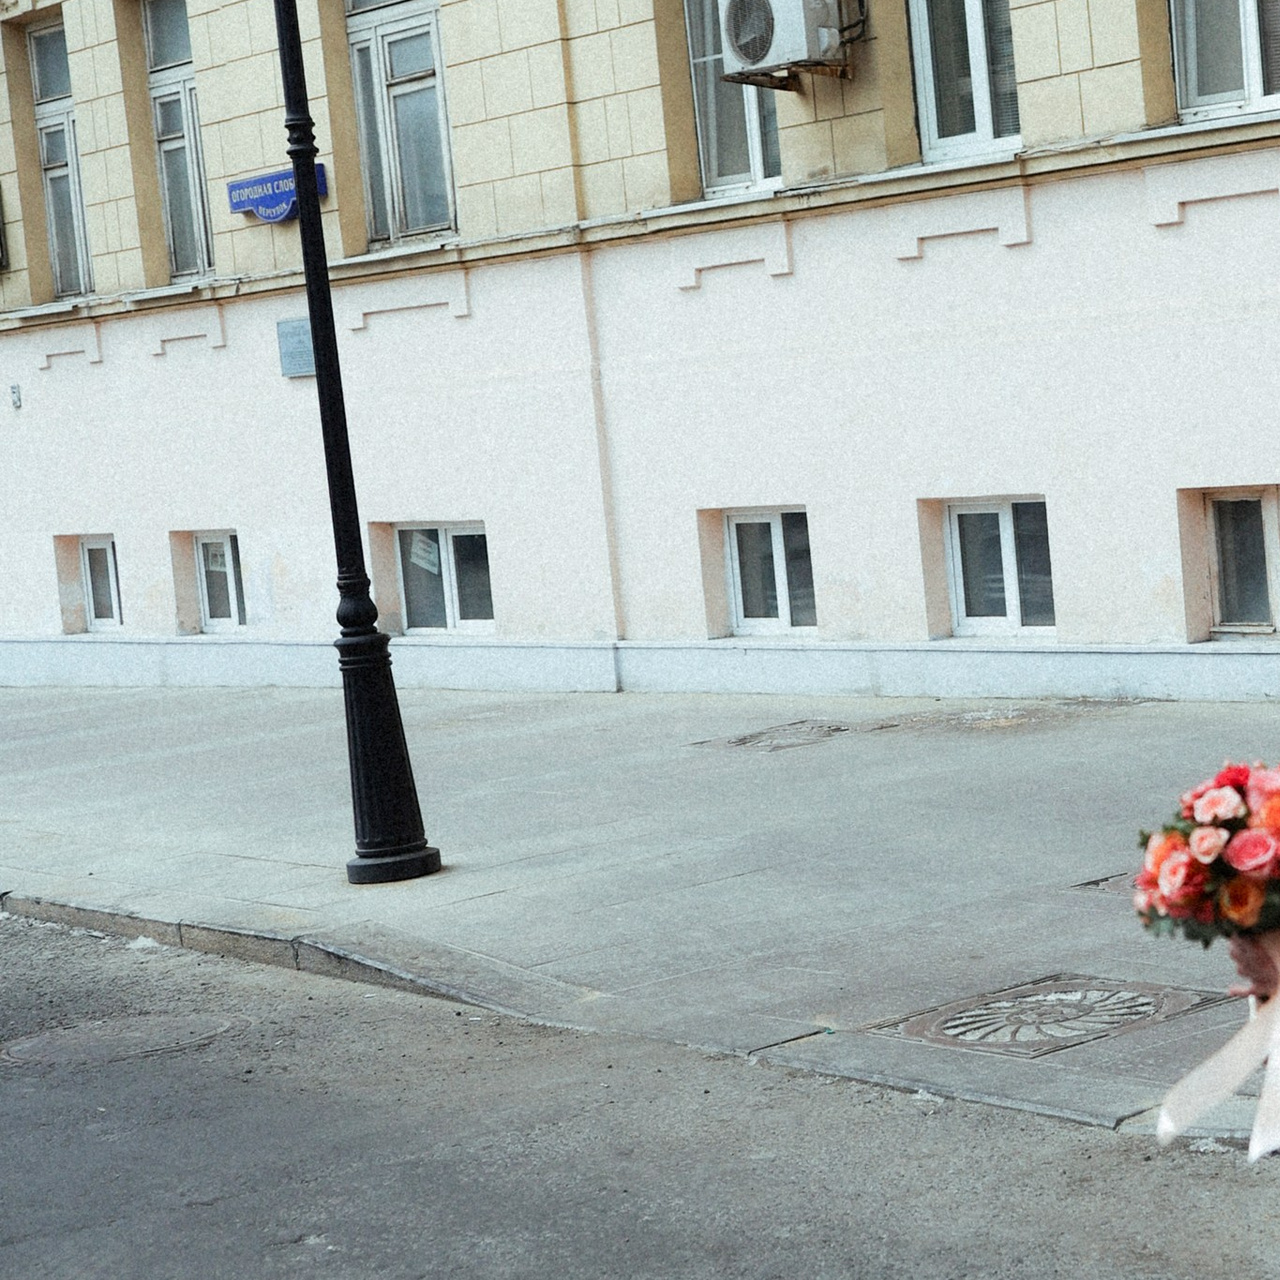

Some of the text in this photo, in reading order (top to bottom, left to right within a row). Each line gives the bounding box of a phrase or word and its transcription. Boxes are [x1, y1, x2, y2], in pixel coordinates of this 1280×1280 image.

[231, 178, 295, 203] ОГОРОДНАЯ СЛОБ
[258, 202, 288, 217] ПЕРЕУЛОК
